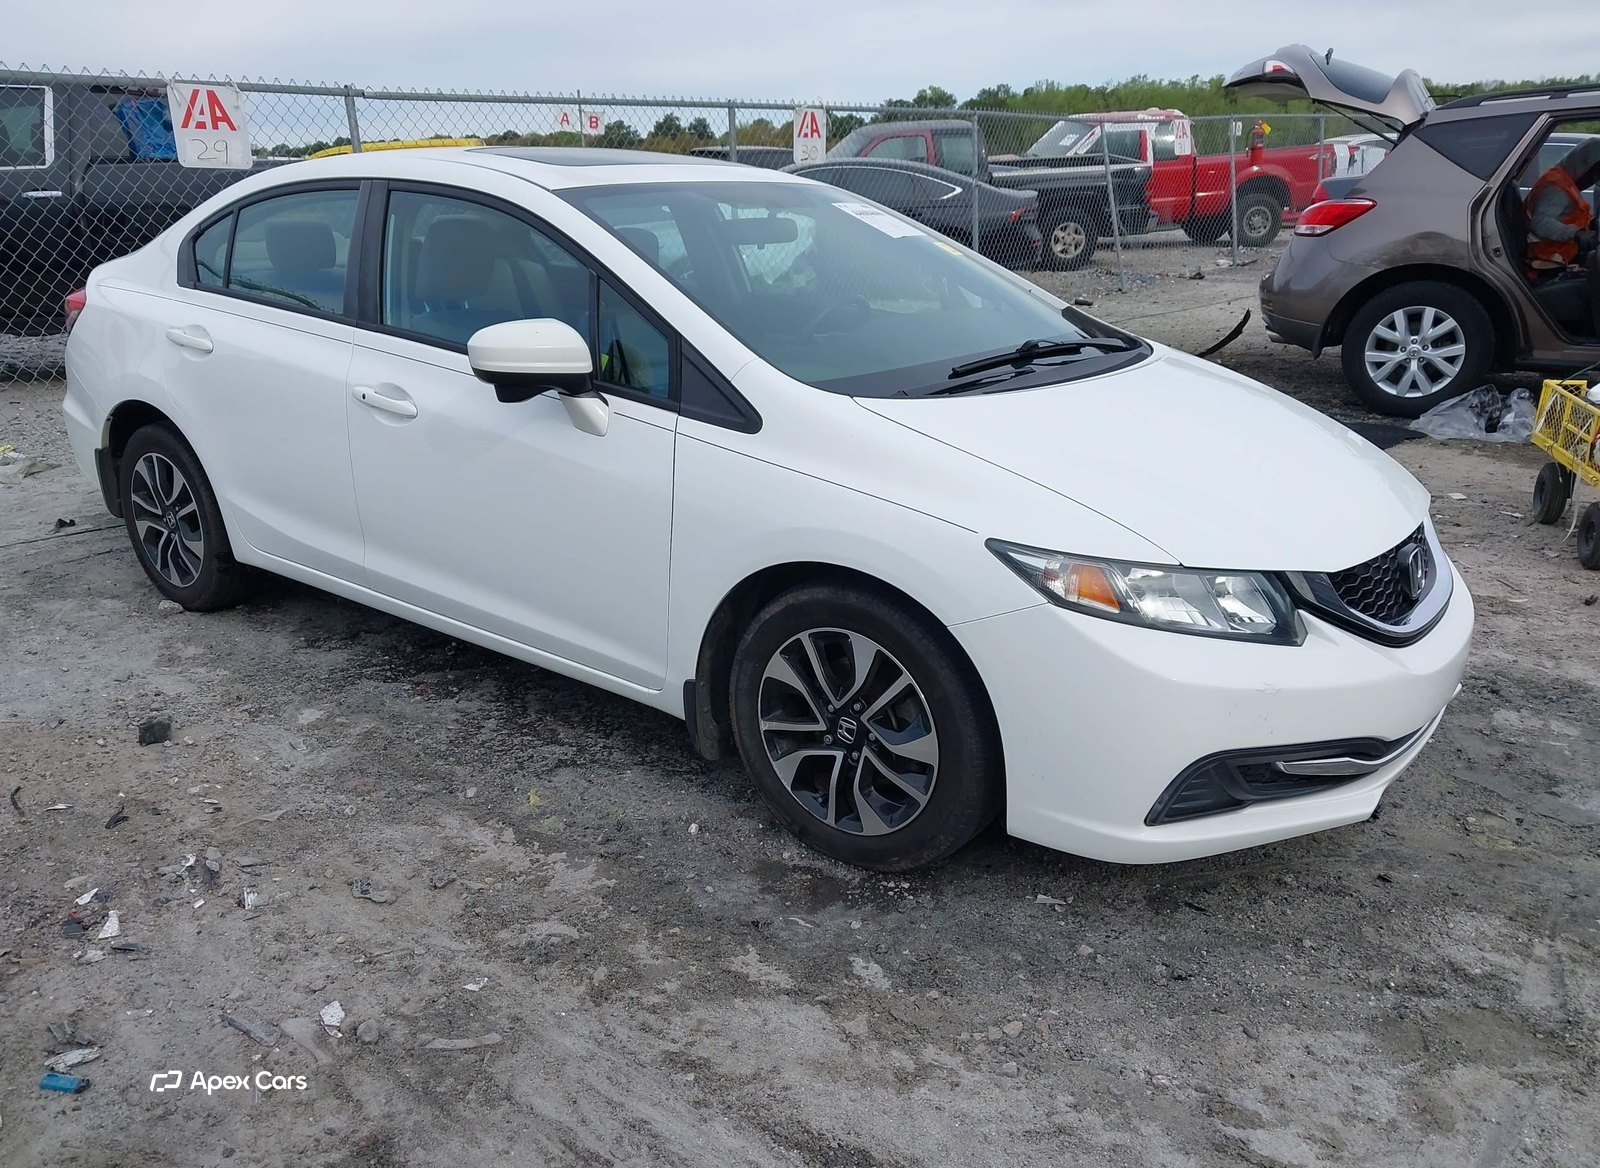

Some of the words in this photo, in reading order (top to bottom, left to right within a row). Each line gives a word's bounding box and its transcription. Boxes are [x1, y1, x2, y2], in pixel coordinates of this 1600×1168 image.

[560, 112, 570, 126] A
[589, 115, 599, 129] B
[190, 138, 229, 164] 29
[800, 144, 819, 161] 30
